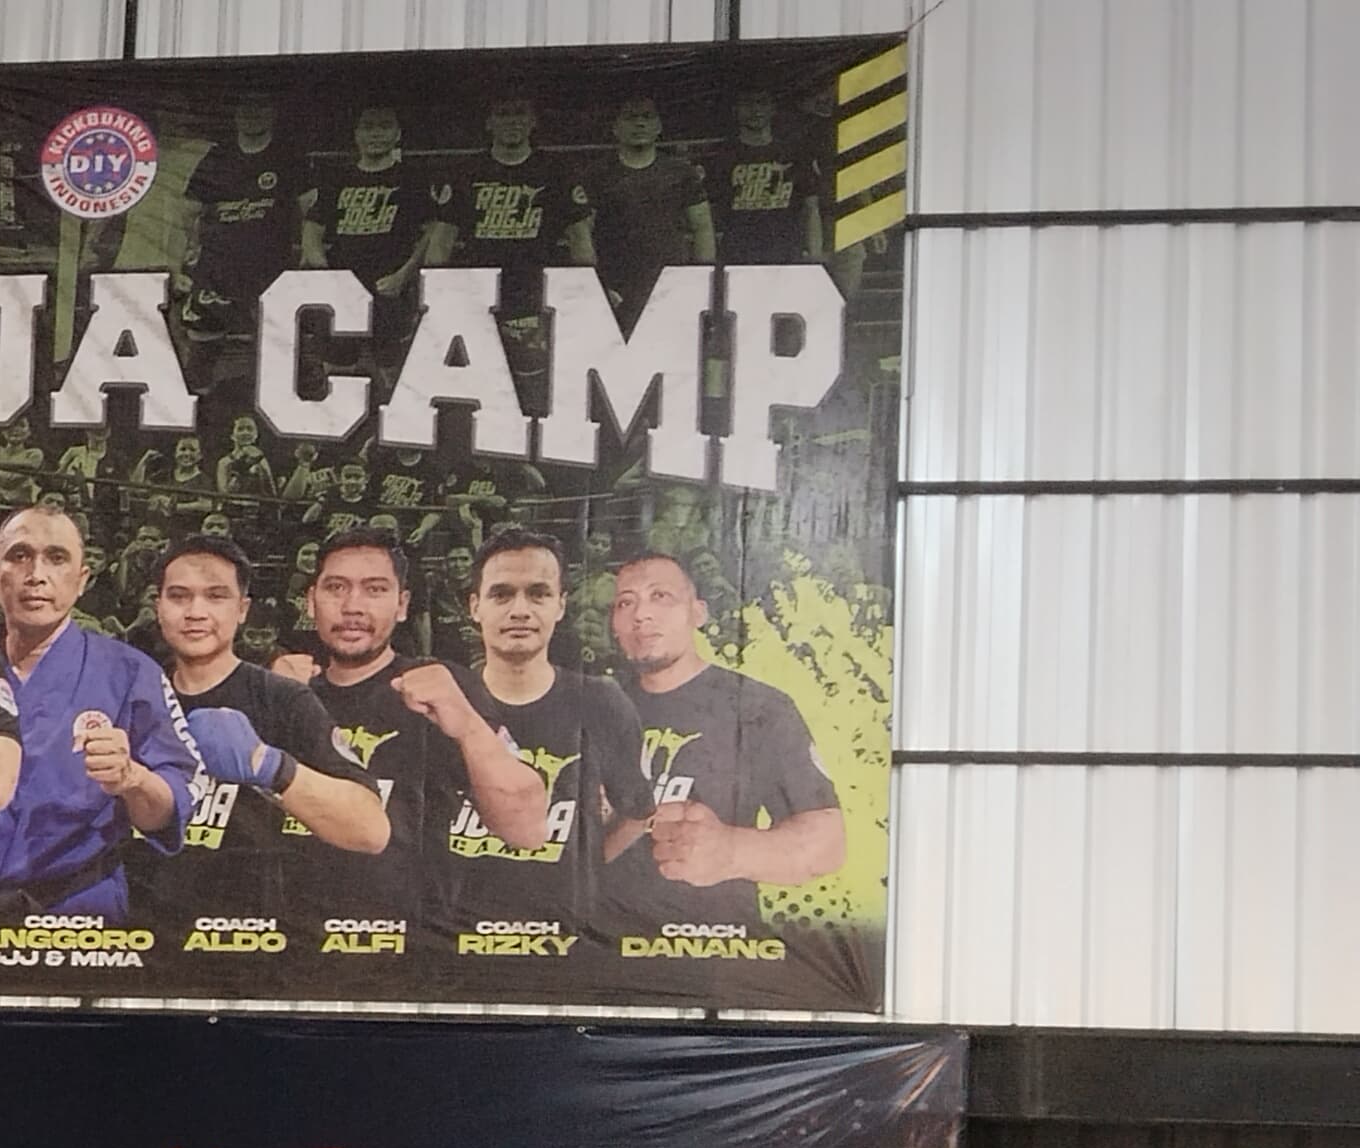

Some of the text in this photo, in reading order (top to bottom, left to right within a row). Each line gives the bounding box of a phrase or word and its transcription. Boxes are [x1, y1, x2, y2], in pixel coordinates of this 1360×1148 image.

[47, 108, 151, 155] KICKBOXING
[68, 156, 130, 175] DIY
[49, 174, 150, 213] INDONESIA
[258, 264, 847, 490] CAMP
[24, 914, 104, 930] COACH
[195, 917, 277, 933] COACH
[323, 918, 407, 935] COACH
[476, 920, 560, 936] COACH
[662, 922, 747, 939] COACH
[183, 931, 287, 954] ALDO
[320, 932, 406, 955] ALFI
[457, 935, 579, 958] RIZKY
[621, 936, 787, 960] DANANG
[46, 950, 66, 967] &
[69, 950, 144, 968] MMA
